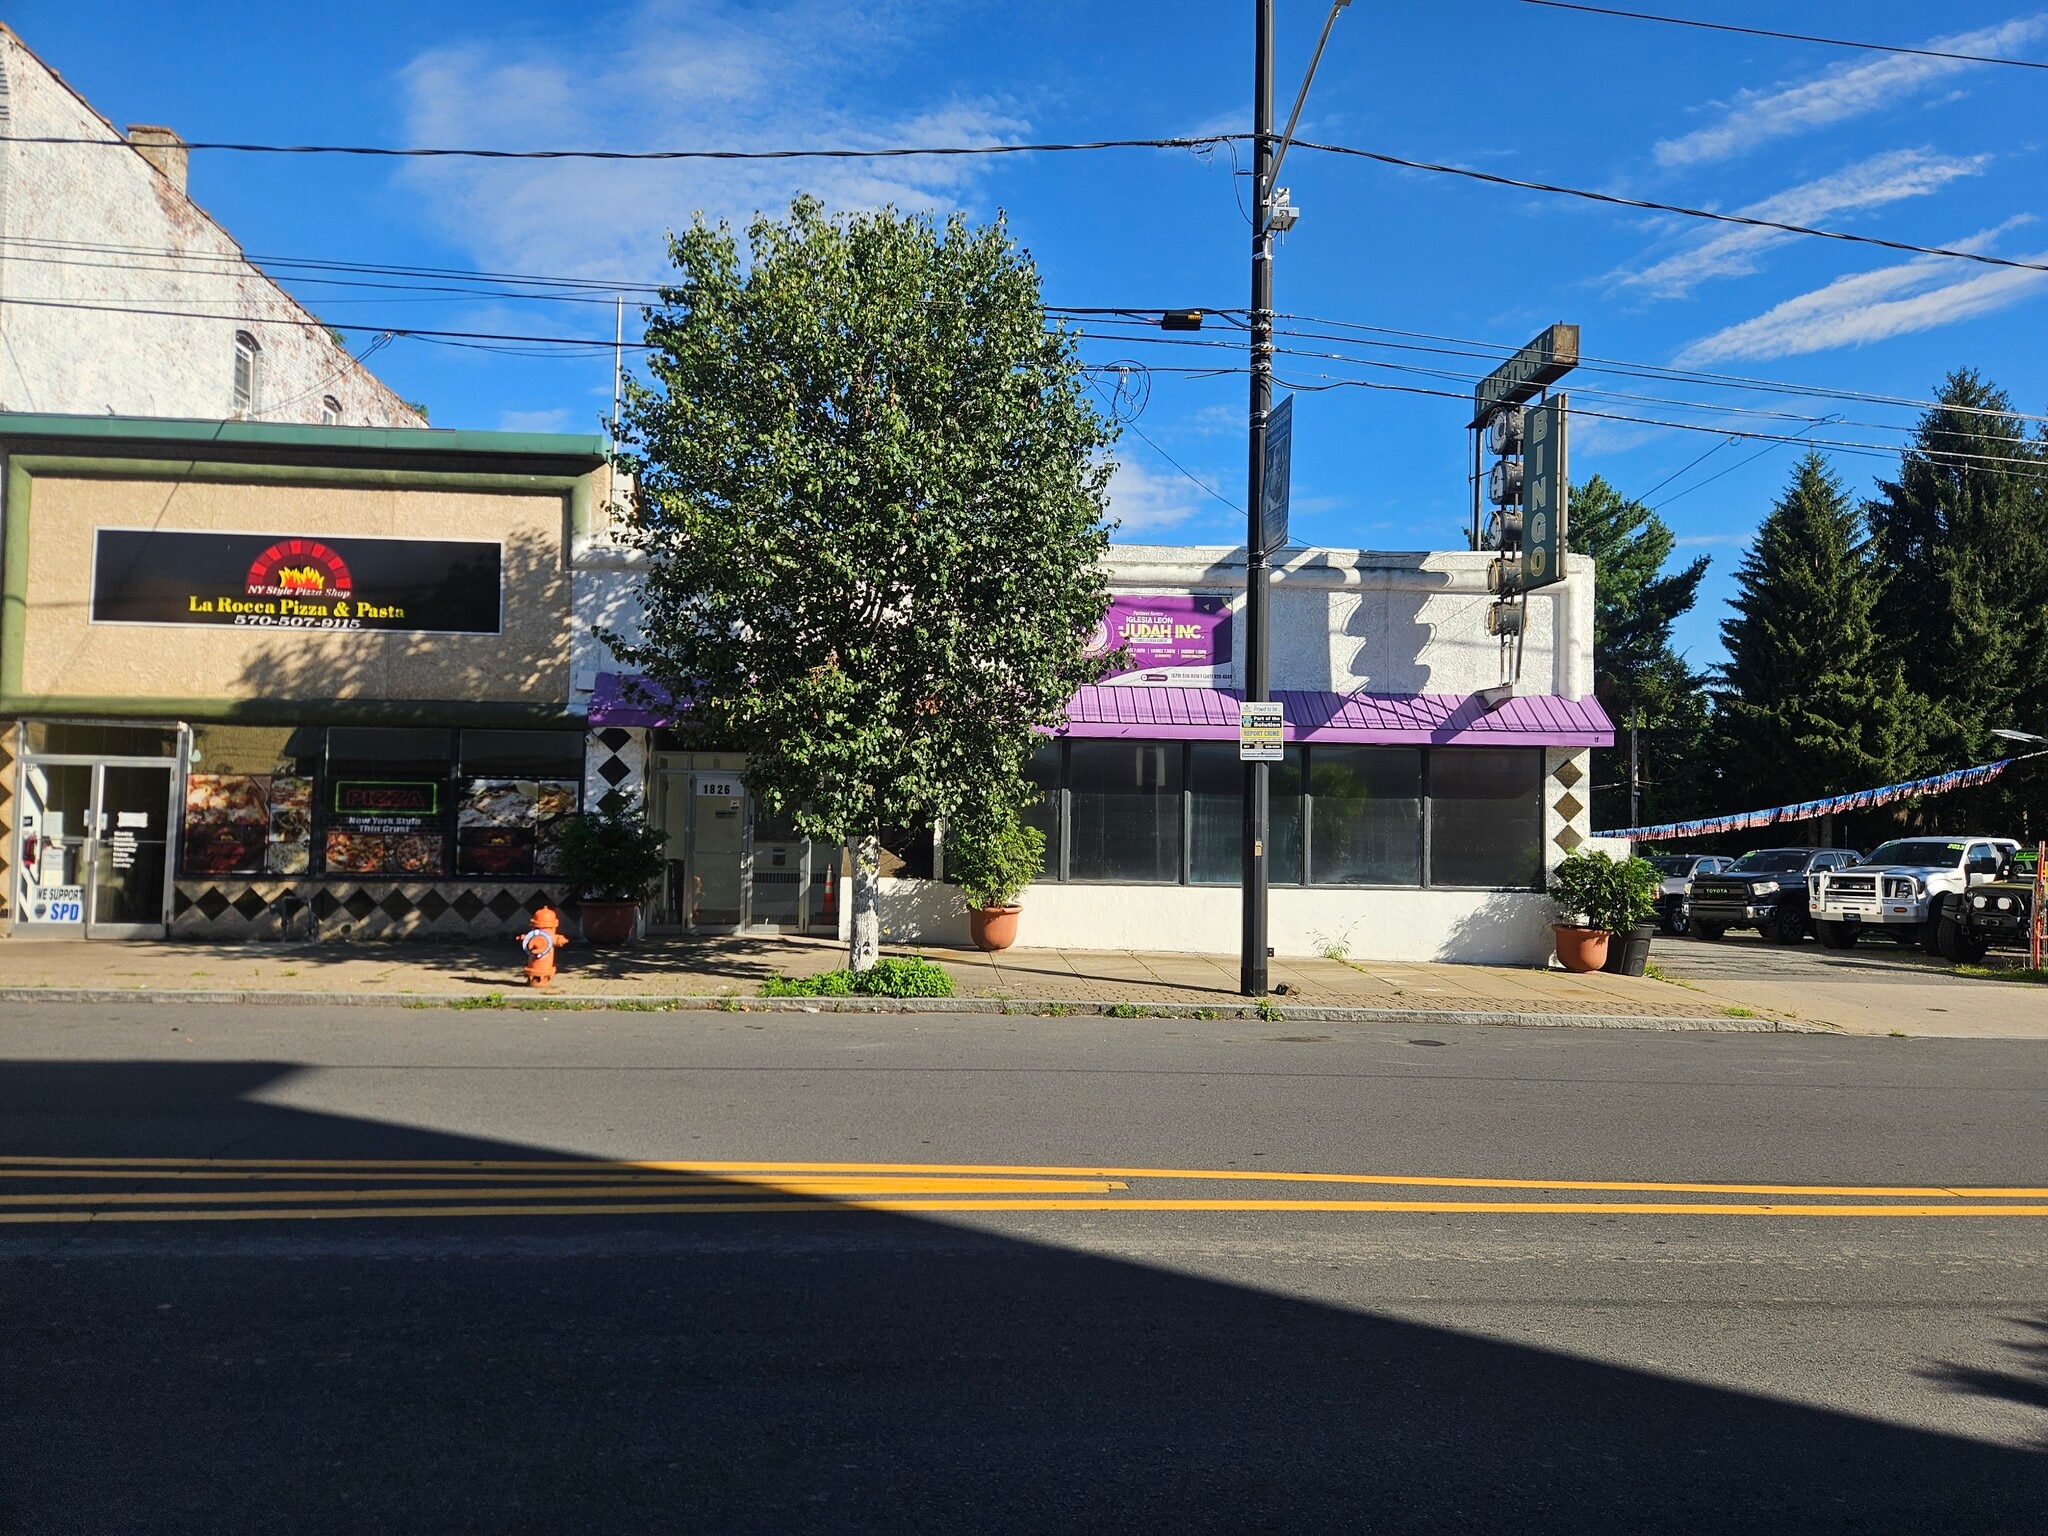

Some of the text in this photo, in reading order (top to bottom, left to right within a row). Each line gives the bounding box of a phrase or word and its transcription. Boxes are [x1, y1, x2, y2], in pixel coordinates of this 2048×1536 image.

[1530, 409, 1548, 577] BINGO
[248, 585, 351, 598] NY Style Pizza Shop
[189, 596, 405, 619] La Rocca Pizza & Pasta
[234, 615, 361, 629] 570-507-9115
[1126, 614, 1174, 625] IGLESIA LEÓN
[1119, 623, 1172, 639] JUDAH
[1175, 624, 1205, 639] INC.
[703, 784, 730, 795] 1826
[346, 790, 426, 806] PIZZA
[348, 816, 422, 826] New York Style
[359, 825, 410, 833] Thin Crust
[37, 888, 84, 900] WE SUPPORT
[50, 903, 79, 920] SPD
